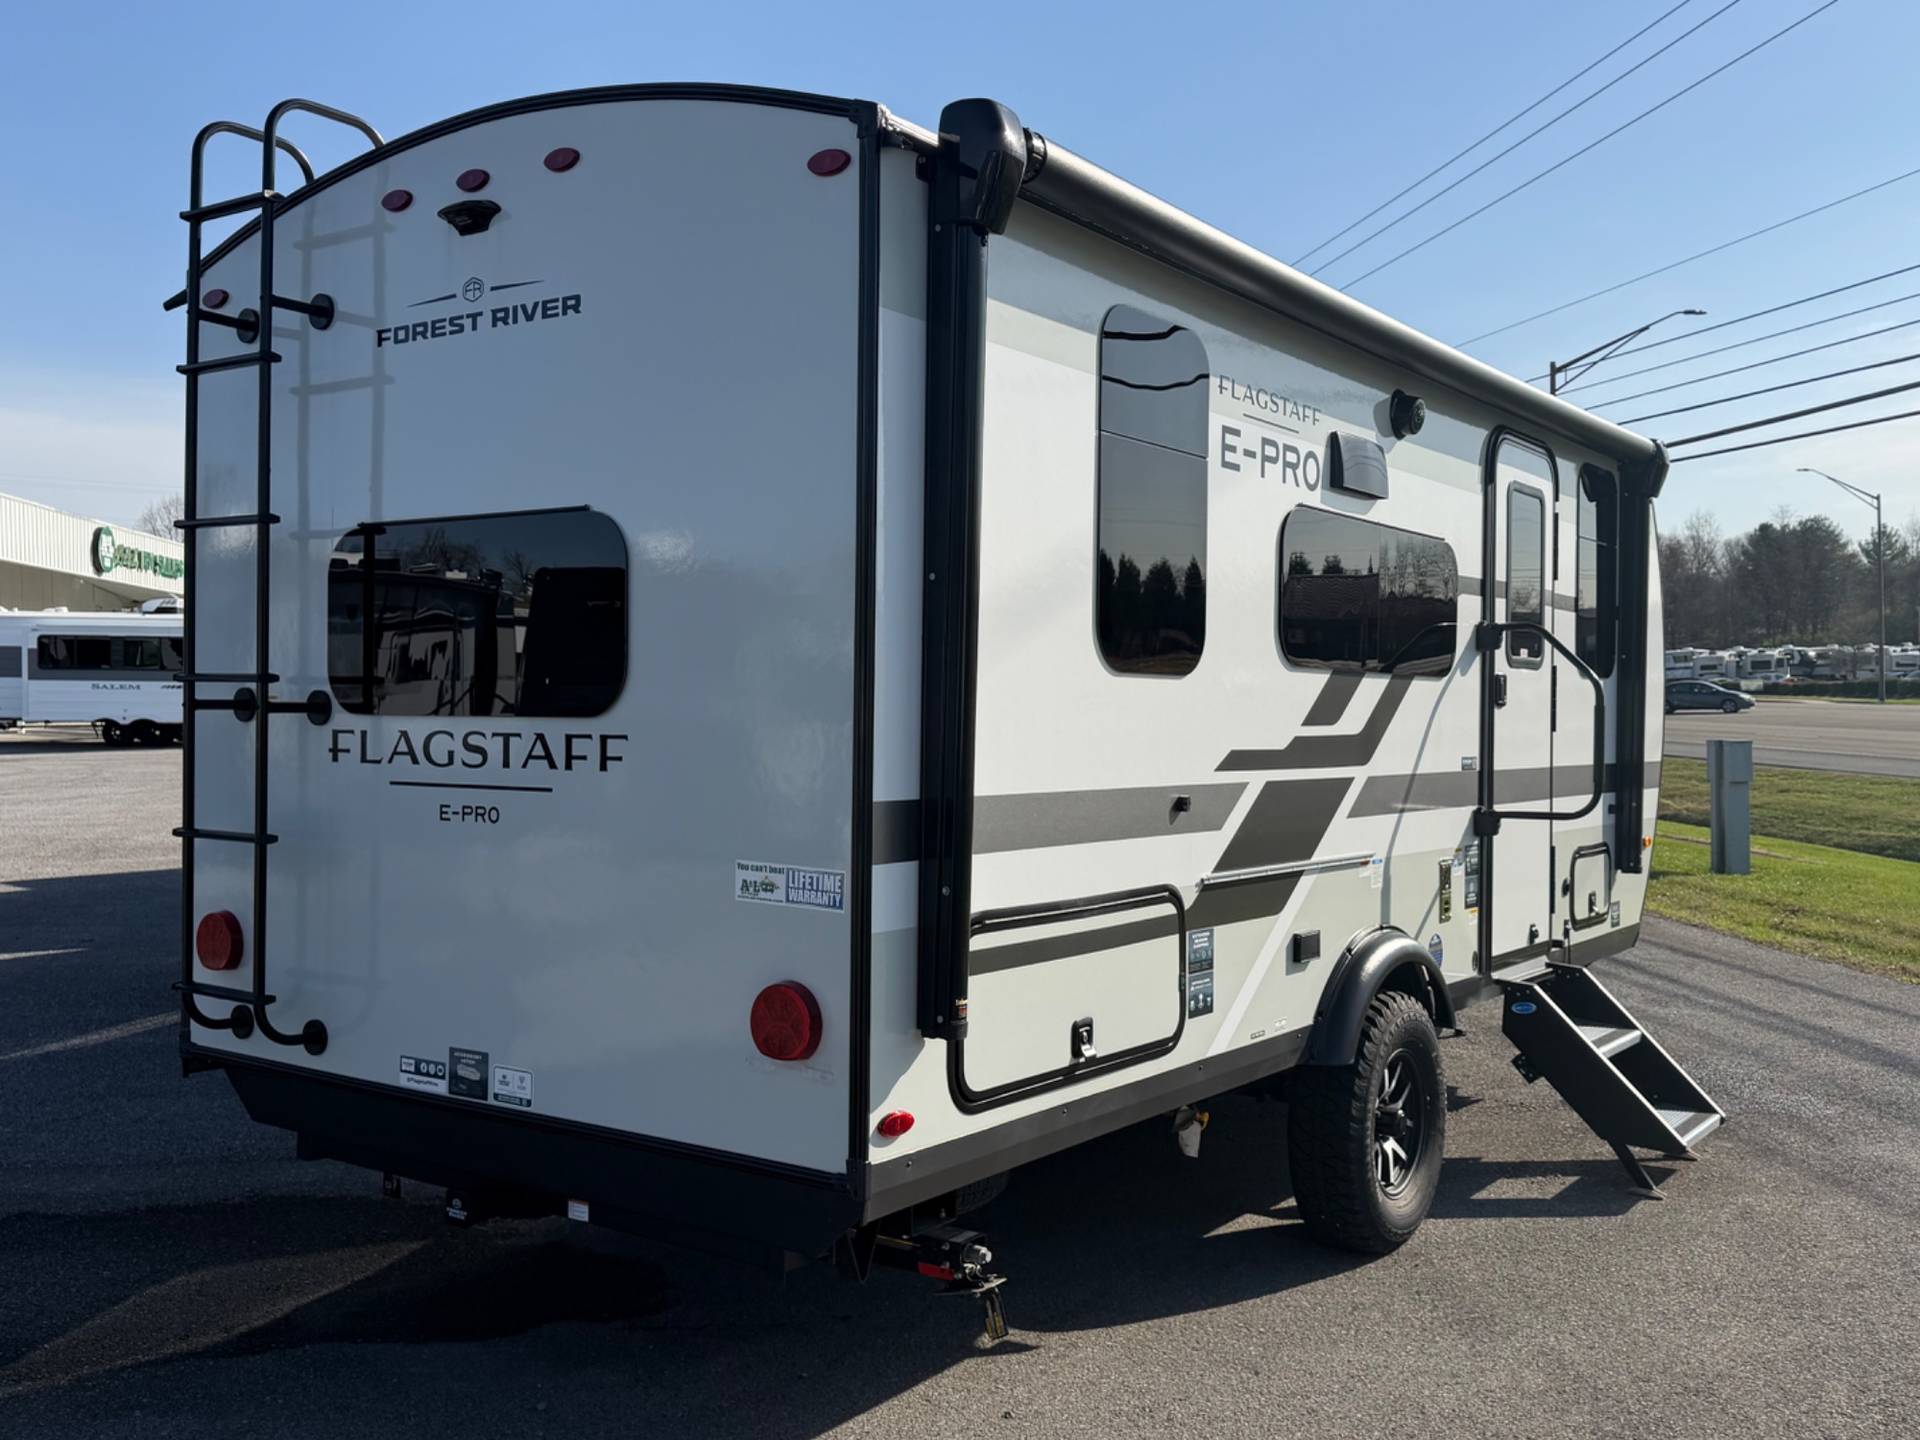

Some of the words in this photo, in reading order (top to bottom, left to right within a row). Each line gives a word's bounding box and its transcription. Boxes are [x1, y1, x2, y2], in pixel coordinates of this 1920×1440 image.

[376, 311, 483, 348] FOREST
[490, 293, 582, 328] RIVER
[1218, 374, 1321, 426] FLAGSTAFF
[1221, 424, 1321, 492] E-PRO
[328, 729, 629, 772] FLAGSTAFF
[439, 804, 500, 824] E-PRO
[788, 869, 842, 893] LIFETIME
[788, 887, 842, 907] WARRANTY
